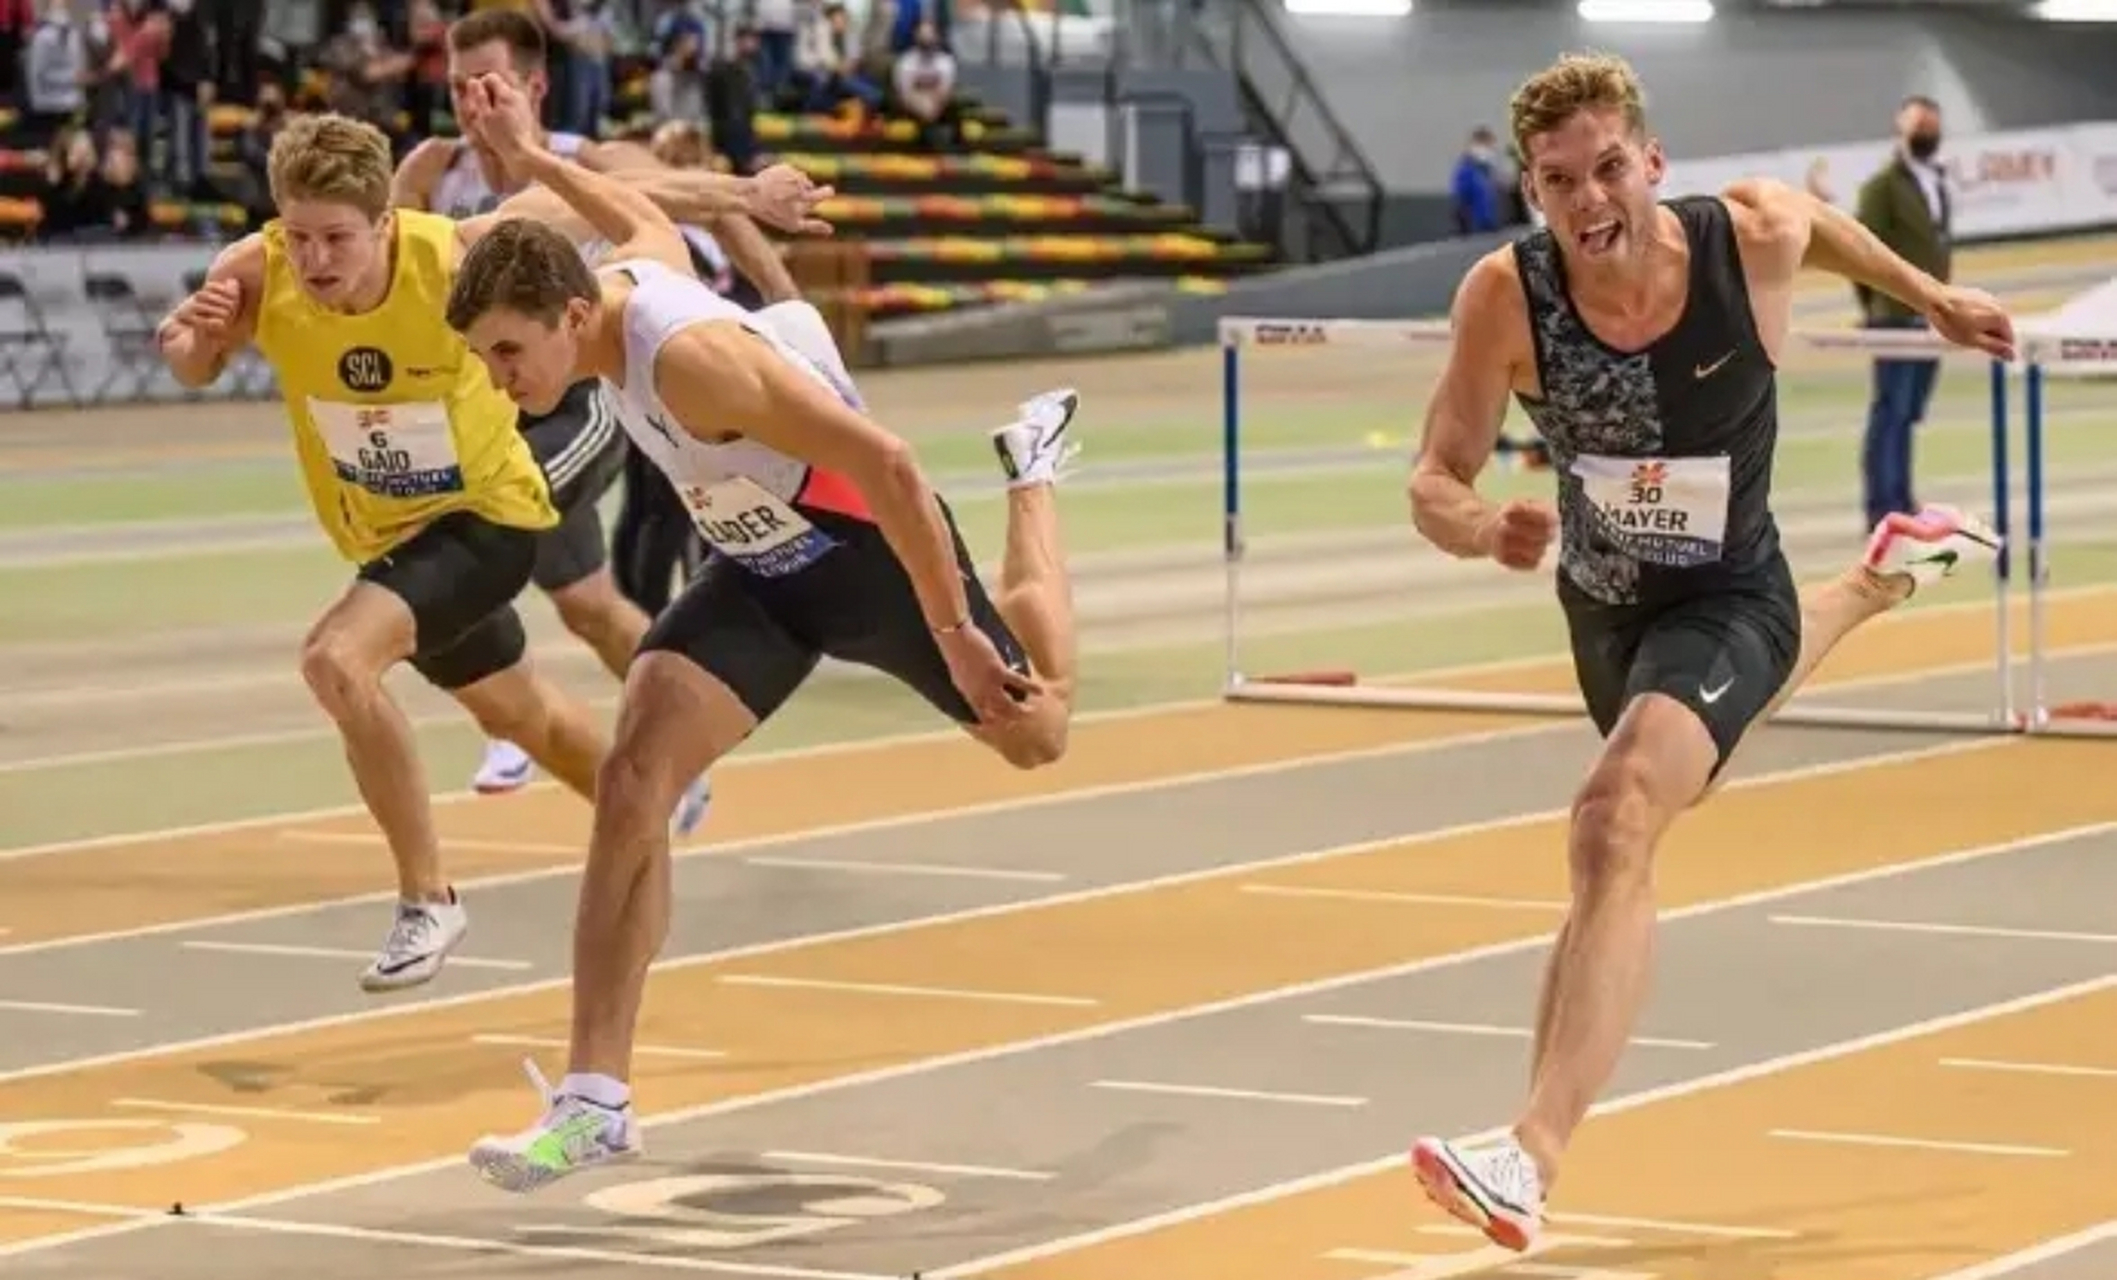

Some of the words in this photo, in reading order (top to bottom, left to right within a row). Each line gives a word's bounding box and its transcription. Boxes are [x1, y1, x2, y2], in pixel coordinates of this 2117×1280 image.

[369, 431, 388, 448] 6
[1629, 487, 1663, 504] 30
[1600, 507, 1689, 532] MAYER
